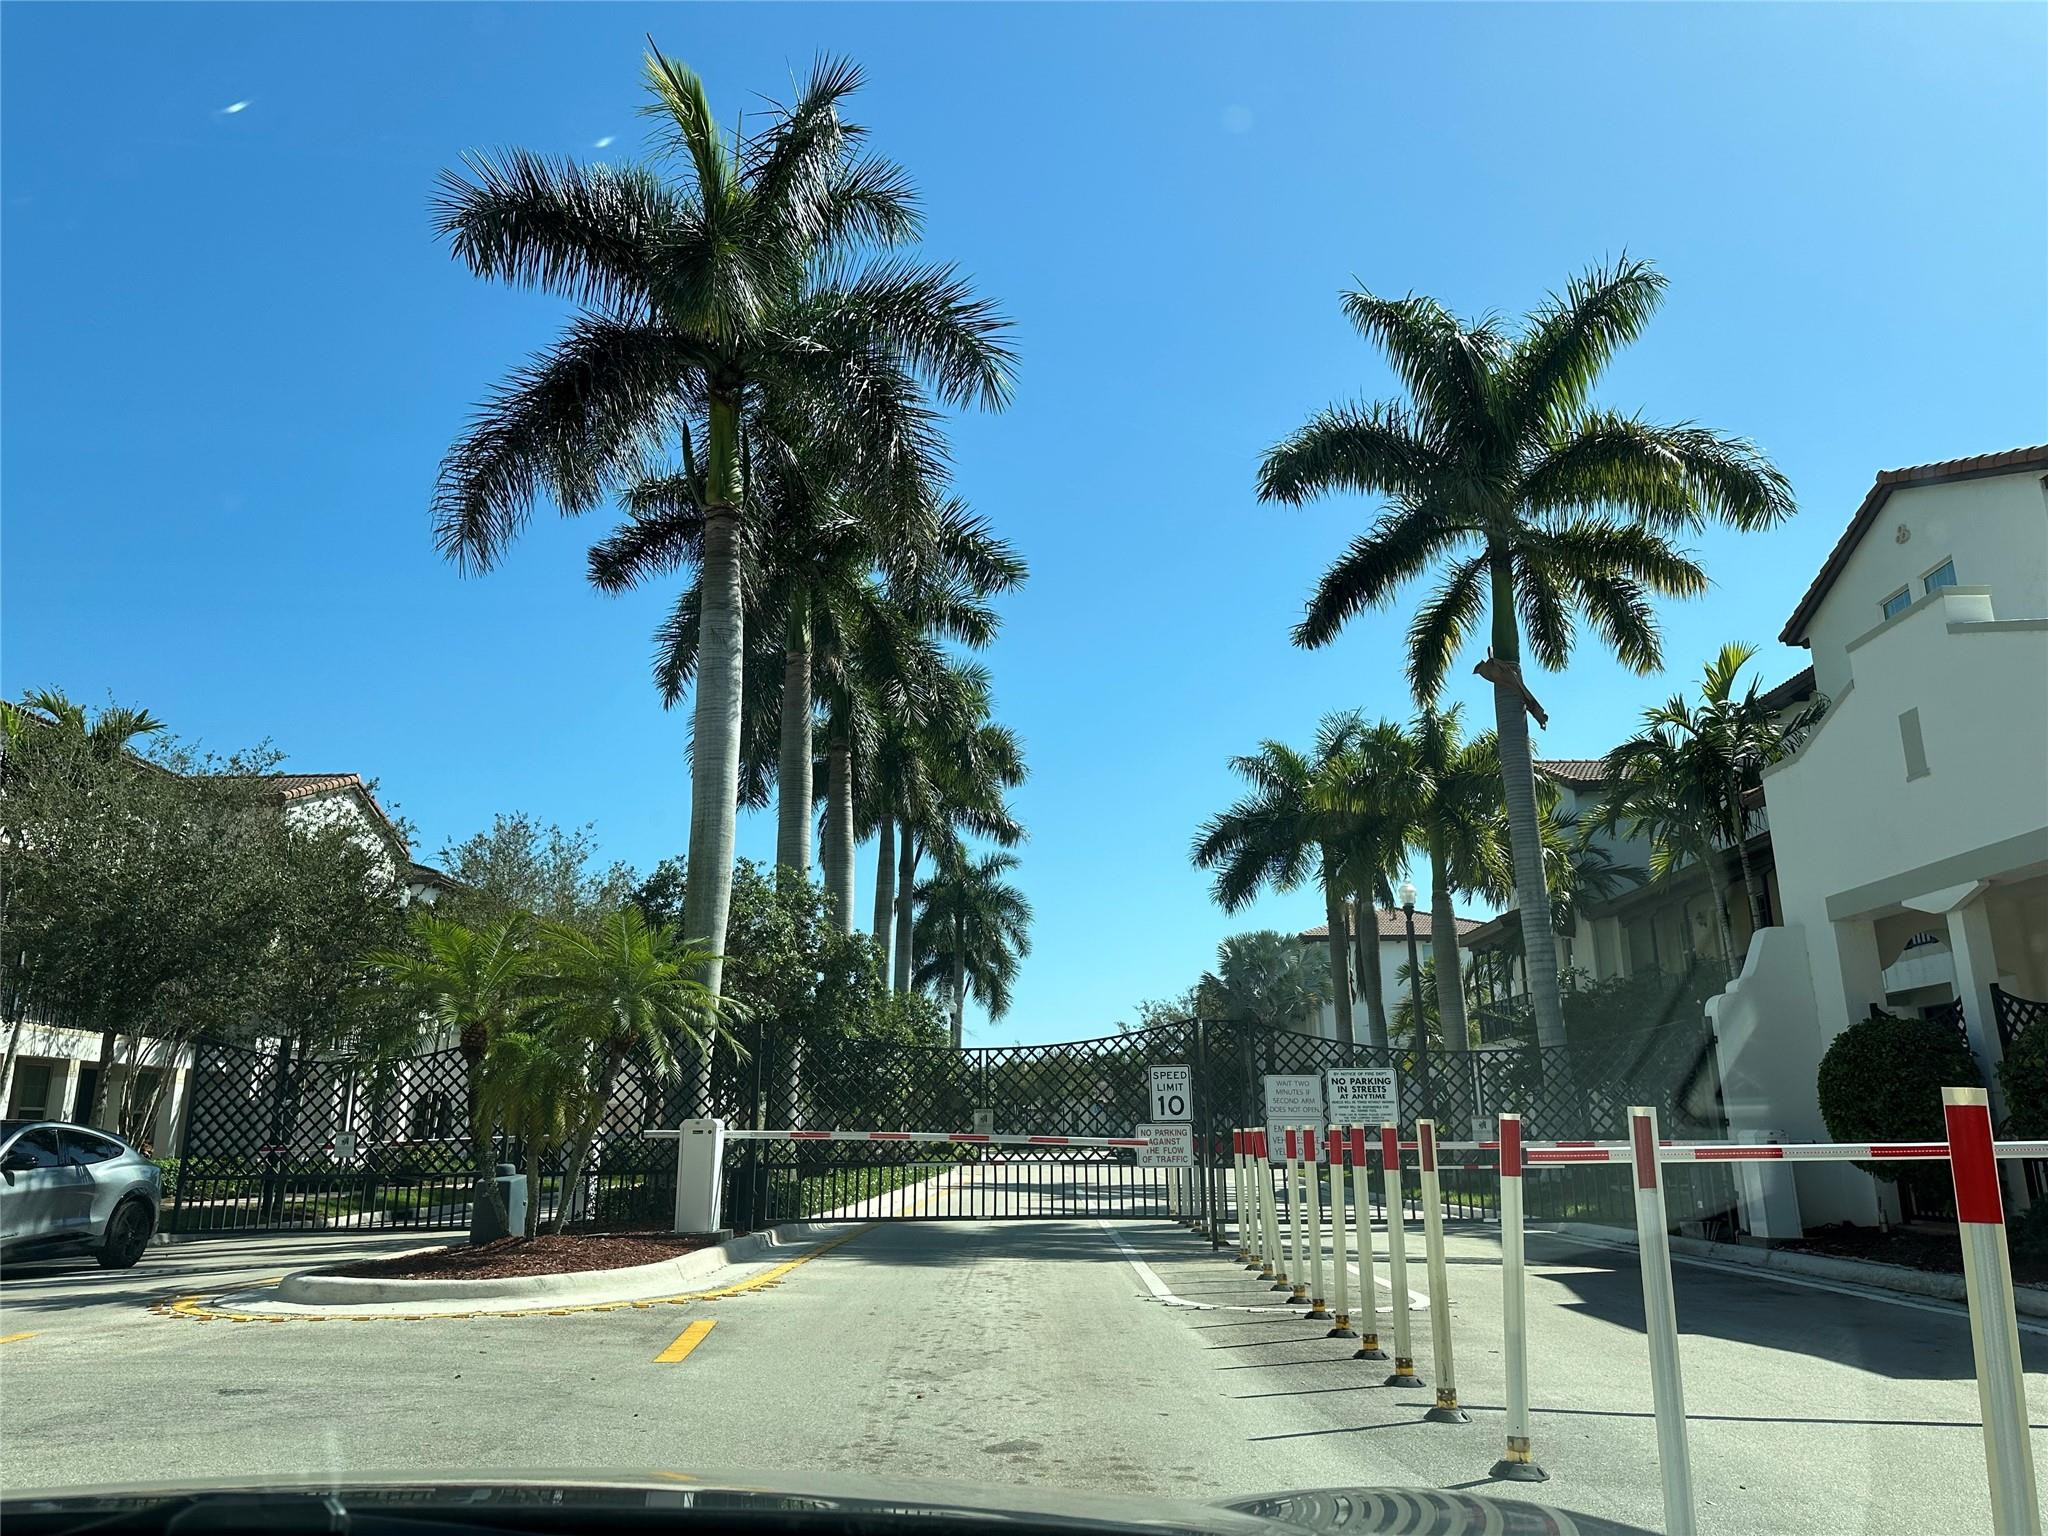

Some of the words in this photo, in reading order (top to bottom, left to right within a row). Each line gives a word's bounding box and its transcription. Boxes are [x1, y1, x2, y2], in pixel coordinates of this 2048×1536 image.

[1153, 1071, 1187, 1080] SPEED
[1157, 1083, 1184, 1092] LIMIT
[1158, 1095, 1185, 1116] 10
